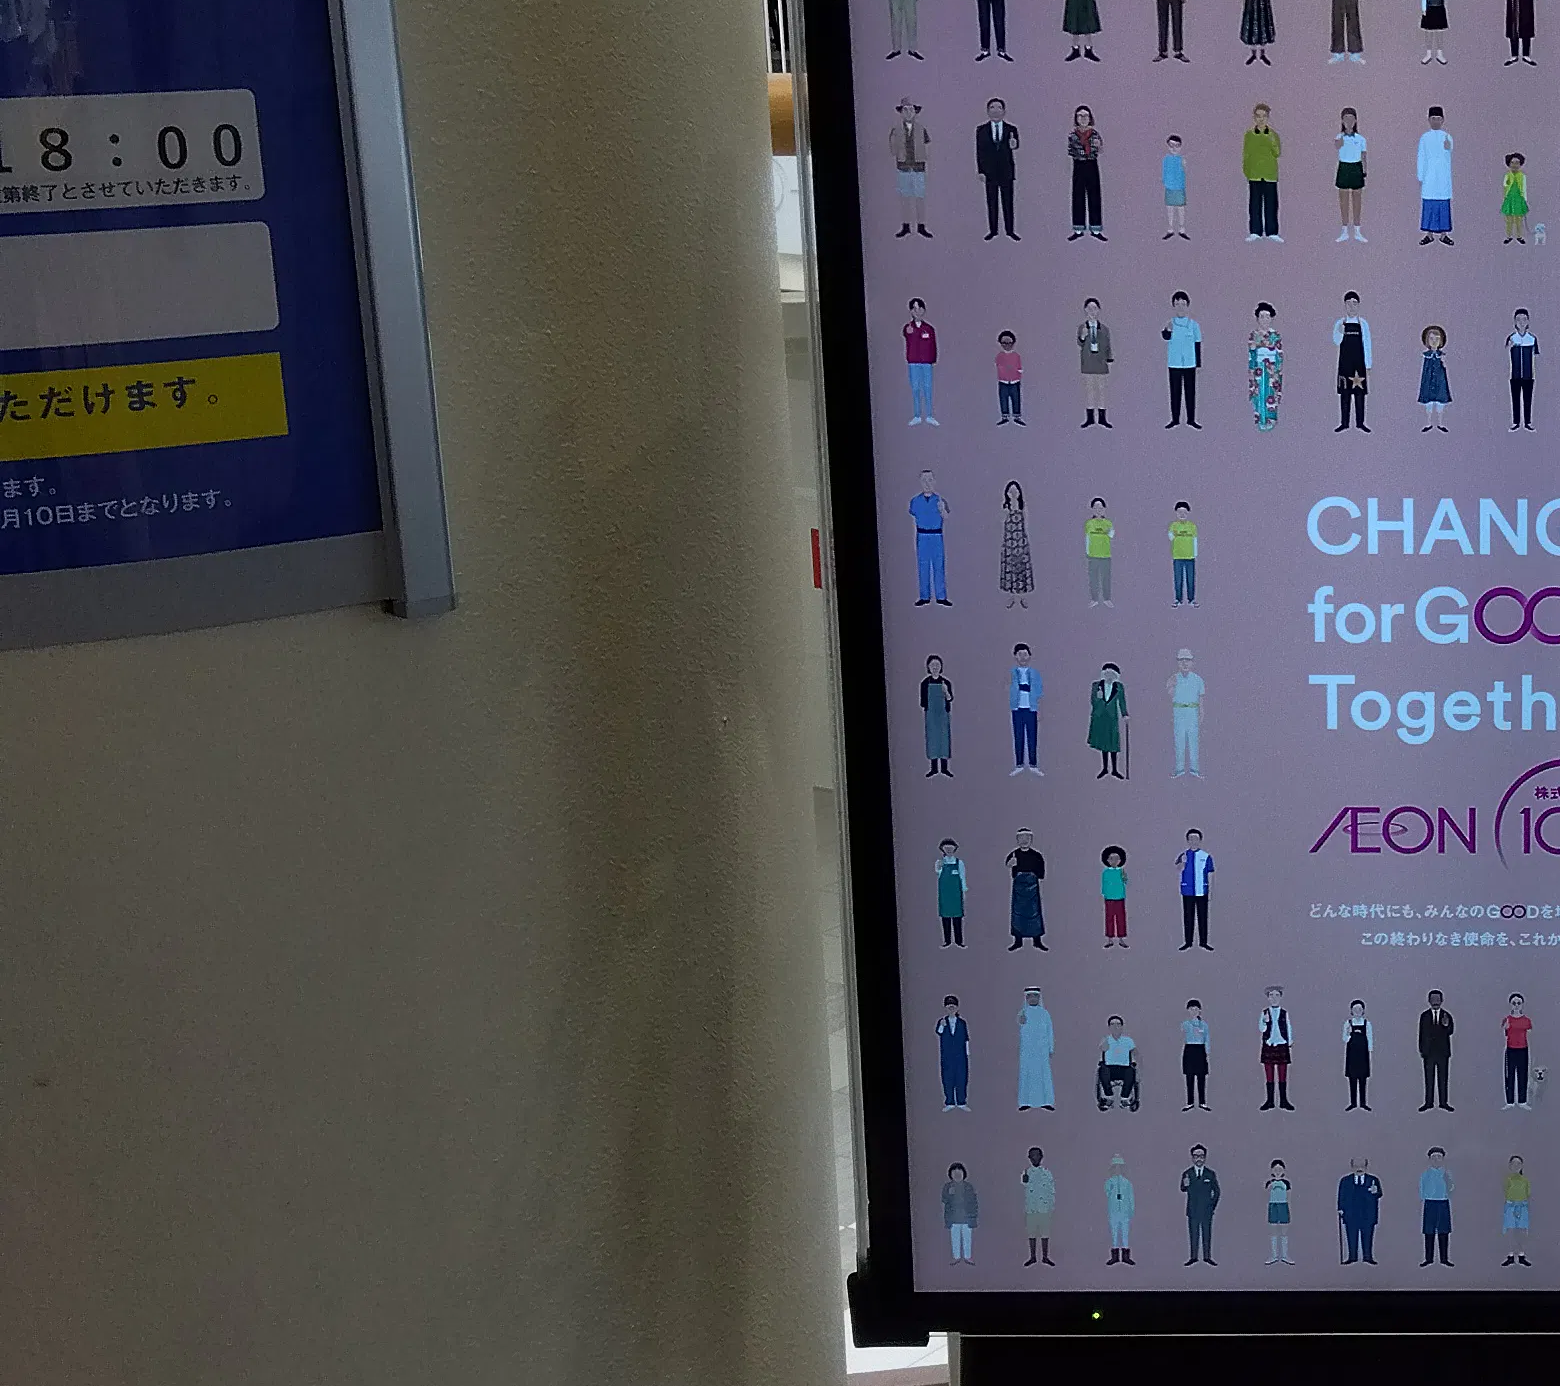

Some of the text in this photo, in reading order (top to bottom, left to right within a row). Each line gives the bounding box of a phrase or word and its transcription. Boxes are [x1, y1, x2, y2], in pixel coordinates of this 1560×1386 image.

[0, 174, 251, 205] 第終了とさせていただきます。
[1307, 586, 1405, 644] for
